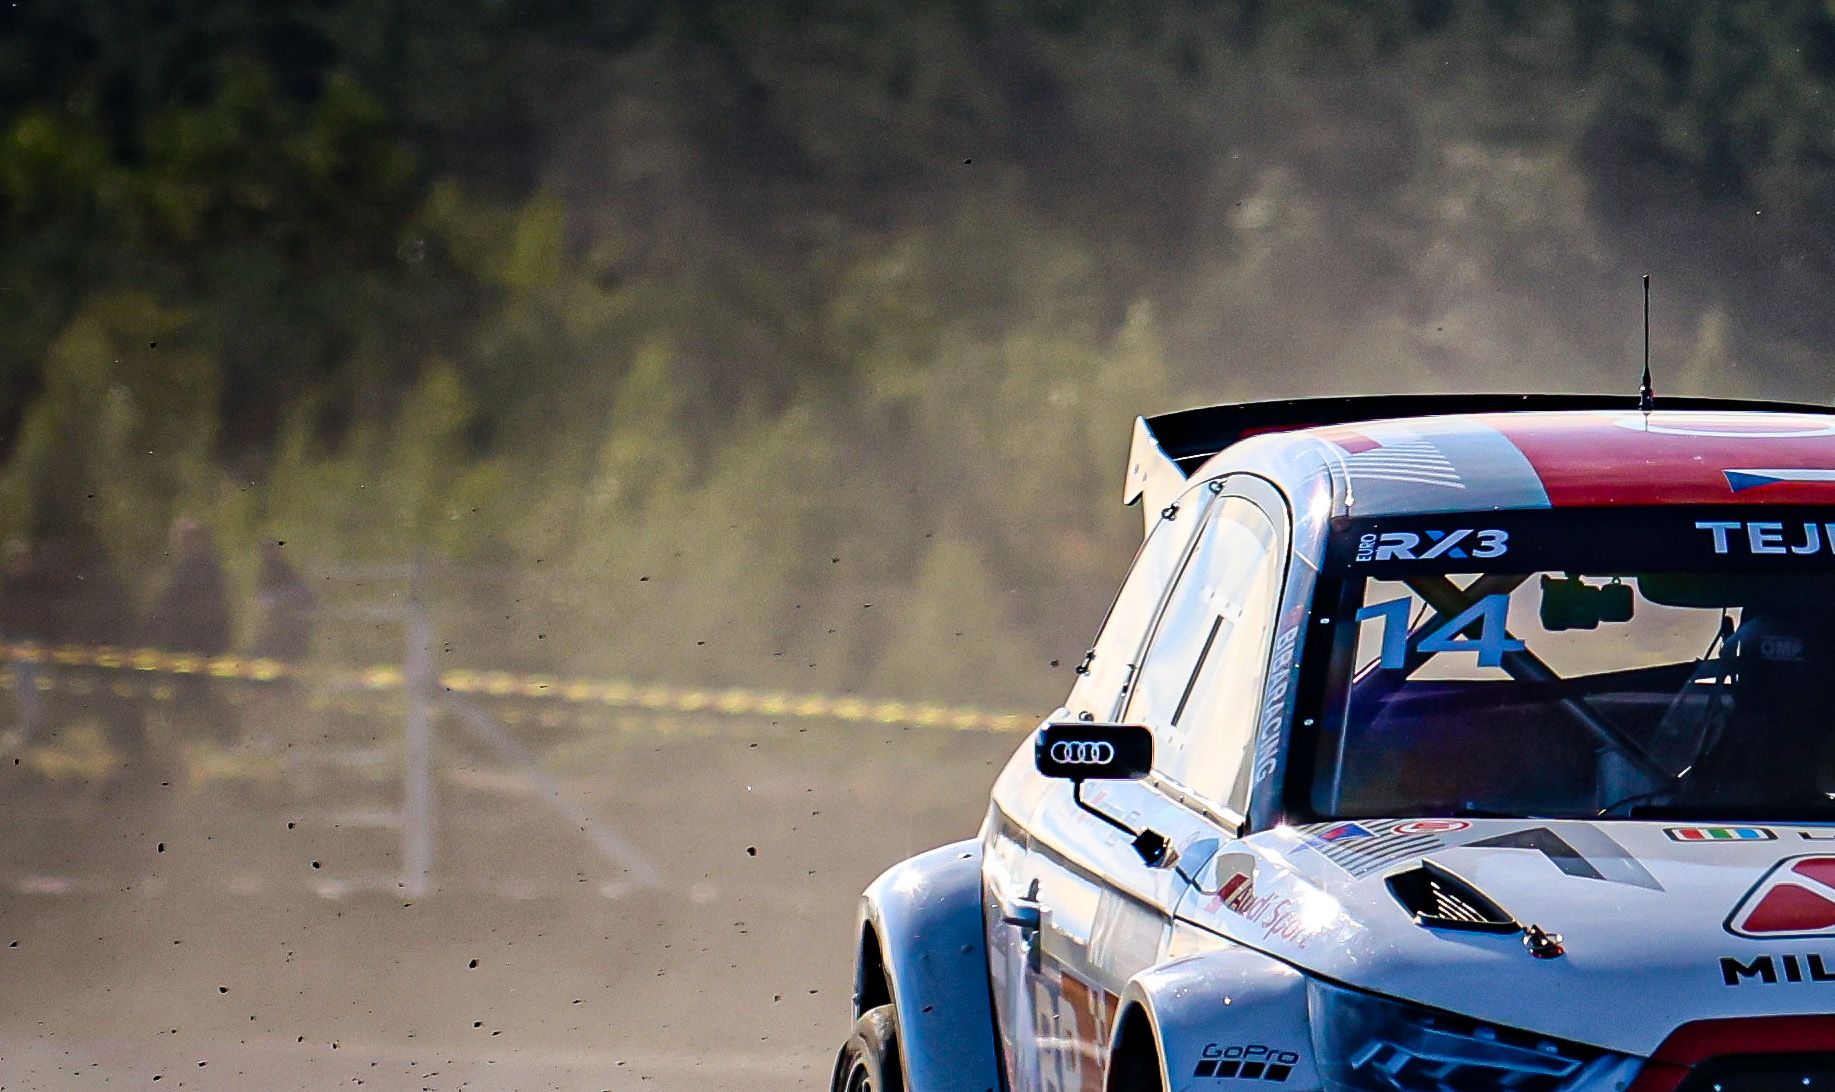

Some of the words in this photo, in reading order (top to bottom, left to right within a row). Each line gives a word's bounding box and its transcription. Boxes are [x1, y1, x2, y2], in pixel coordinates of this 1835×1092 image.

[1356, 533, 1376, 562] EURO
[1374, 529, 1509, 561] RX3
[1356, 594, 1526, 669] 14
[1202, 1043, 1299, 1065] GoPro
